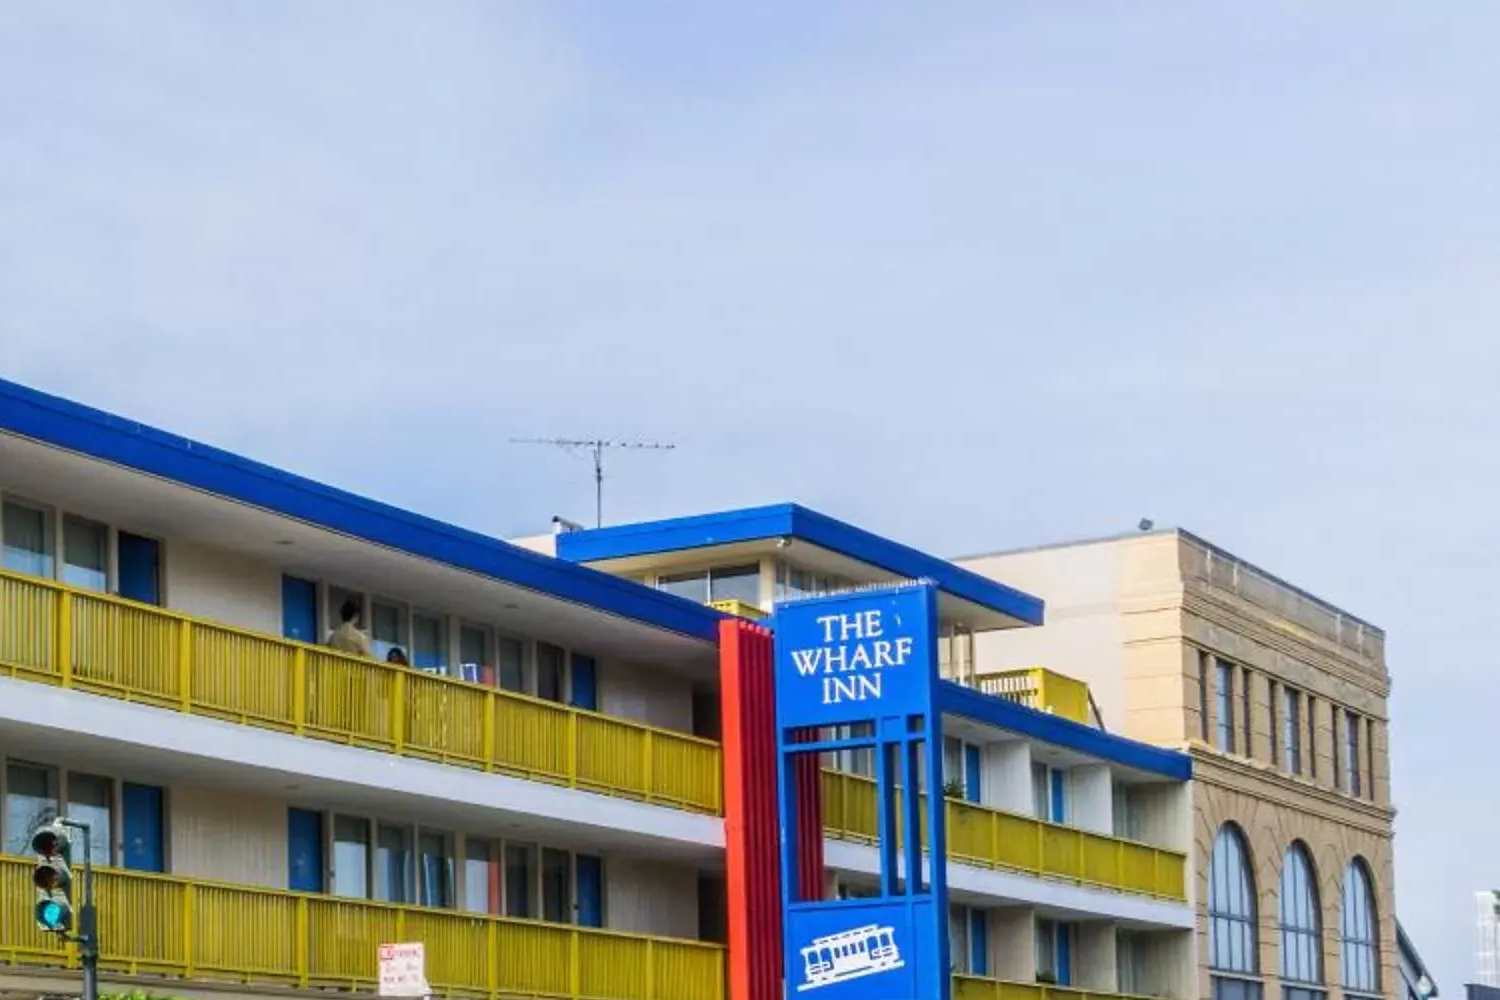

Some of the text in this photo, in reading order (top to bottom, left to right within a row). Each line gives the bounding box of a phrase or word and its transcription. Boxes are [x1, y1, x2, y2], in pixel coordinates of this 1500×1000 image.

[816, 610, 884, 643] THE
[790, 637, 913, 677] WHARF
[822, 673, 882, 704] INN
